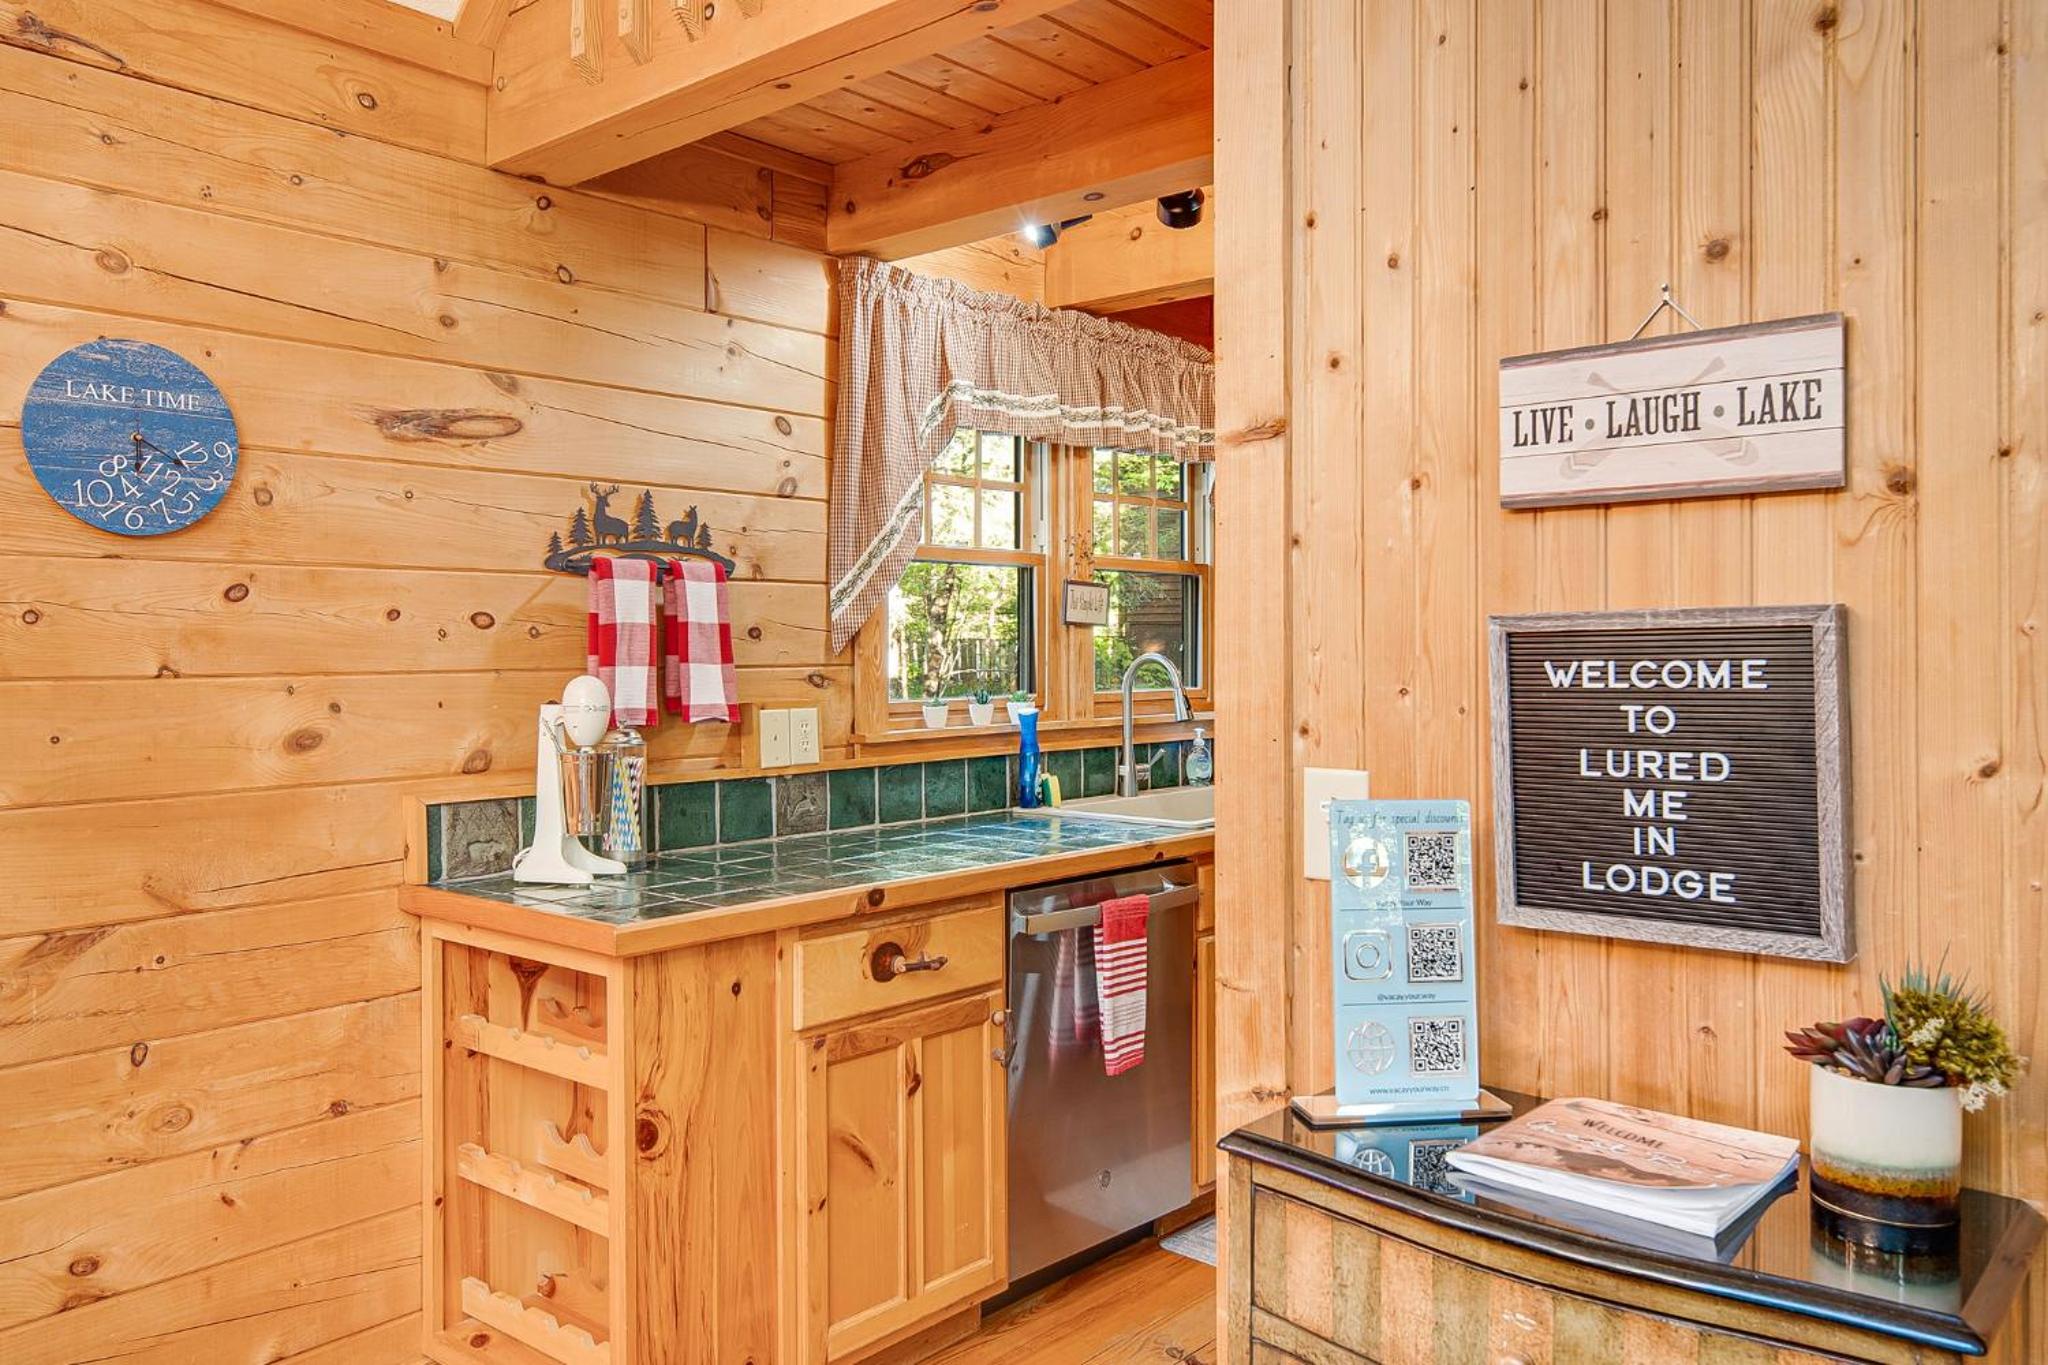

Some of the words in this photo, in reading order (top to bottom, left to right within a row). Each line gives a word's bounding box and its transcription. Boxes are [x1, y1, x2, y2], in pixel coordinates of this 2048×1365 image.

[65, 379, 135, 404] LAKE
[141, 388, 201, 412] TIME
[1513, 405, 1574, 447] LIVE
[1605, 391, 1702, 439] LAUGH
[1736, 378, 1823, 427] LAKE
[99, 454, 128, 478] 8
[213, 441, 233, 467] 9
[131, 455, 164, 486] 11
[161, 470, 182, 497] 2
[195, 470, 224, 492] 3
[73, 478, 113, 508] 10
[120, 474, 144, 499] 4
[124, 505, 147, 530] 6
[150, 498, 177, 525] 7
[172, 491, 201, 514] 5
[1543, 658, 1768, 690] WELCOME
[1619, 704, 1677, 735] TO
[1579, 748, 1732, 782] LURED
[1391, 810, 1420, 828] special
[1622, 788, 1689, 821] ME
[1632, 826, 1676, 856] IN
[1582, 861, 1737, 903] LODGE
[1583, 1118, 1669, 1149] WELCOME
